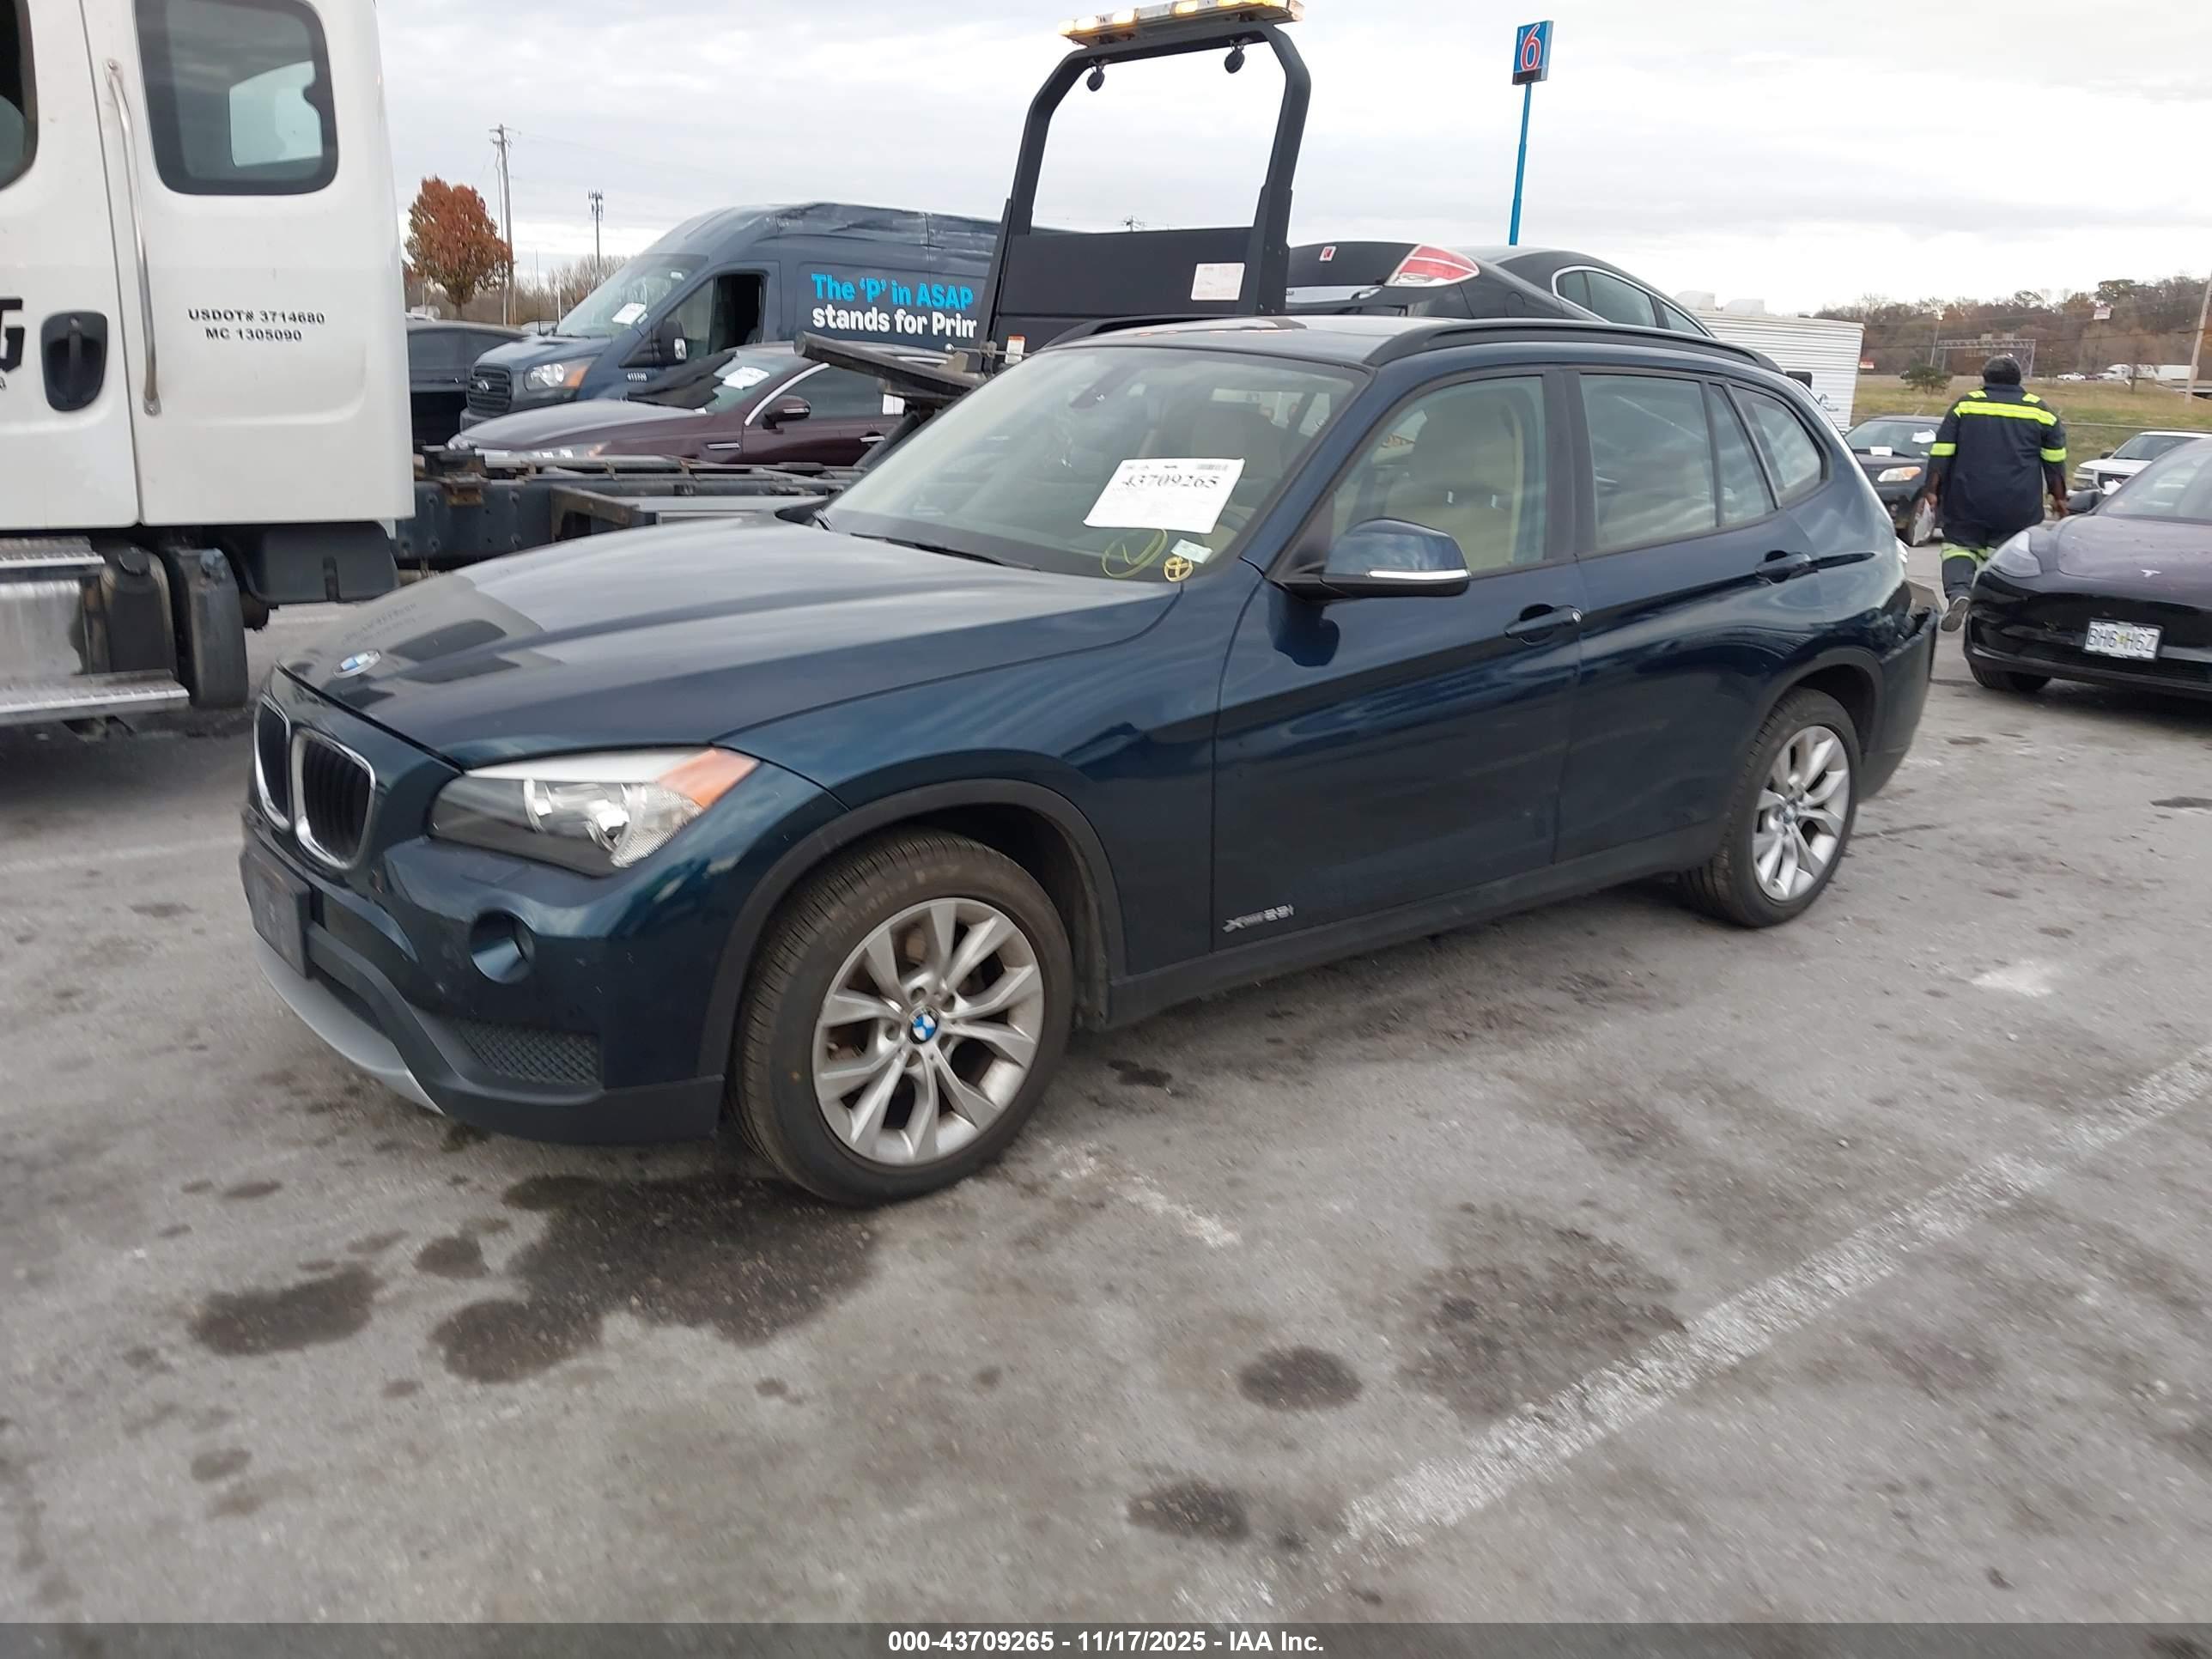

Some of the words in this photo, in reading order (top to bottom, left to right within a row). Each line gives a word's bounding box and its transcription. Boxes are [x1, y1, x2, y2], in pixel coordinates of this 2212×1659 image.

[1521, 24, 1541, 70] 6
[811, 273, 856, 301] The
[891, 279, 912, 307] in
[916, 283, 974, 311] ASAP
[187, 308, 254, 322] USDOT#
[259, 310, 325, 325] 3714680
[812, 304, 890, 332] stands
[894, 308, 928, 335] for
[205, 327, 230, 340] MC
